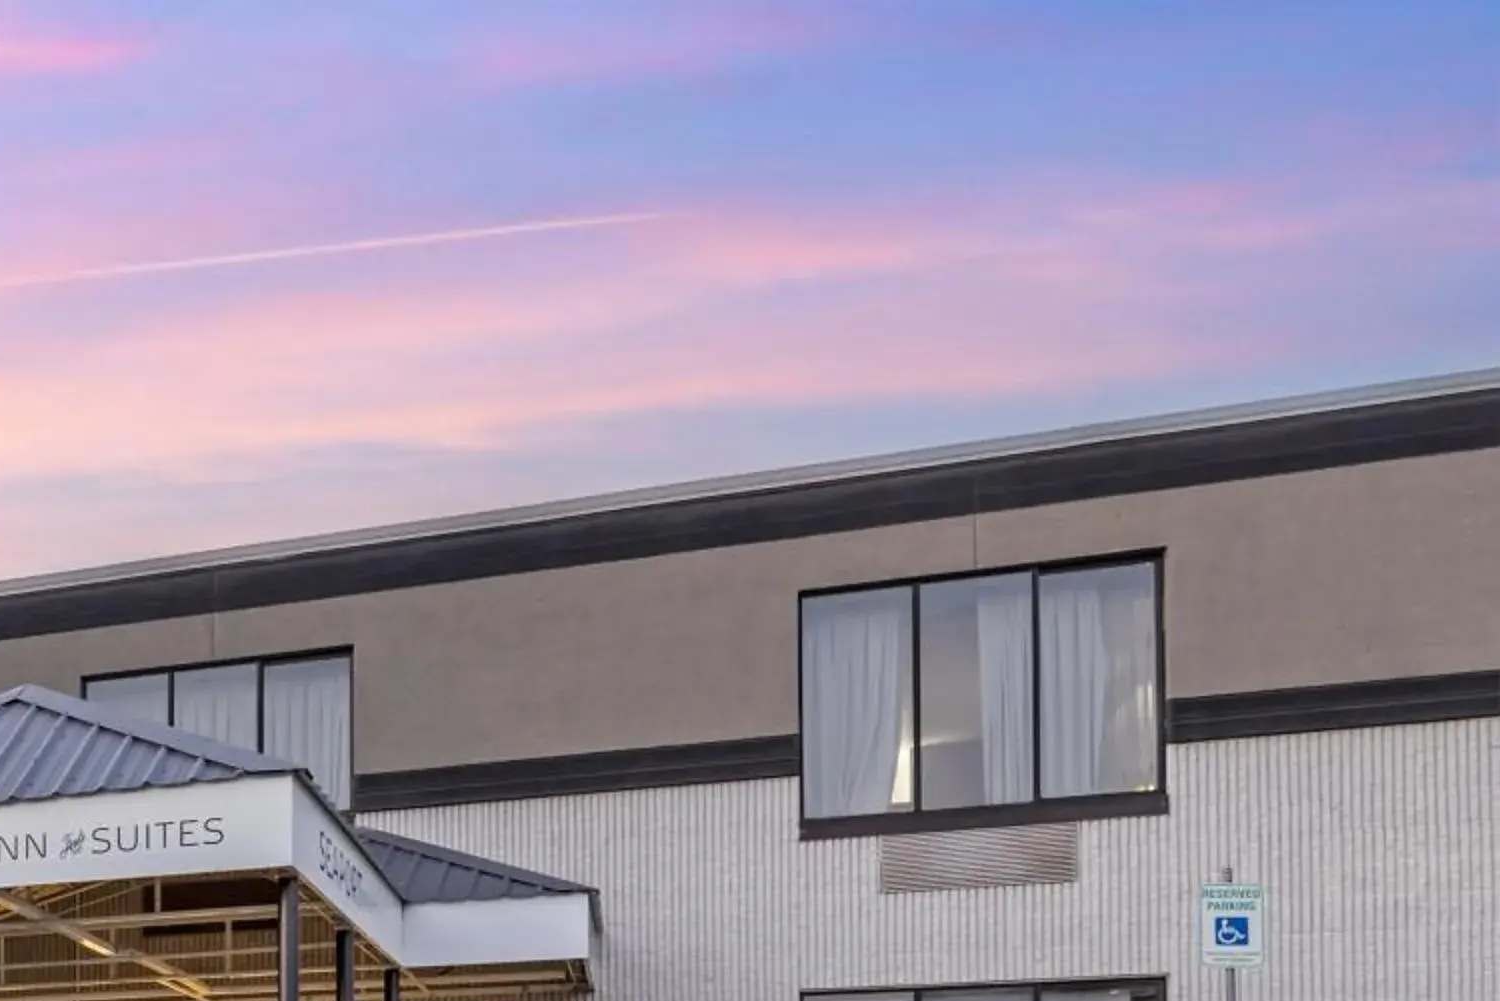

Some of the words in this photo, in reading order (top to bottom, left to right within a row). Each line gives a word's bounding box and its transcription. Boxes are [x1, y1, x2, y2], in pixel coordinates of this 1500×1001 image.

[90, 817, 225, 856] SUITES
[1202, 888, 1261, 899] RESERVED
[1207, 901, 1257, 911] PARKING
